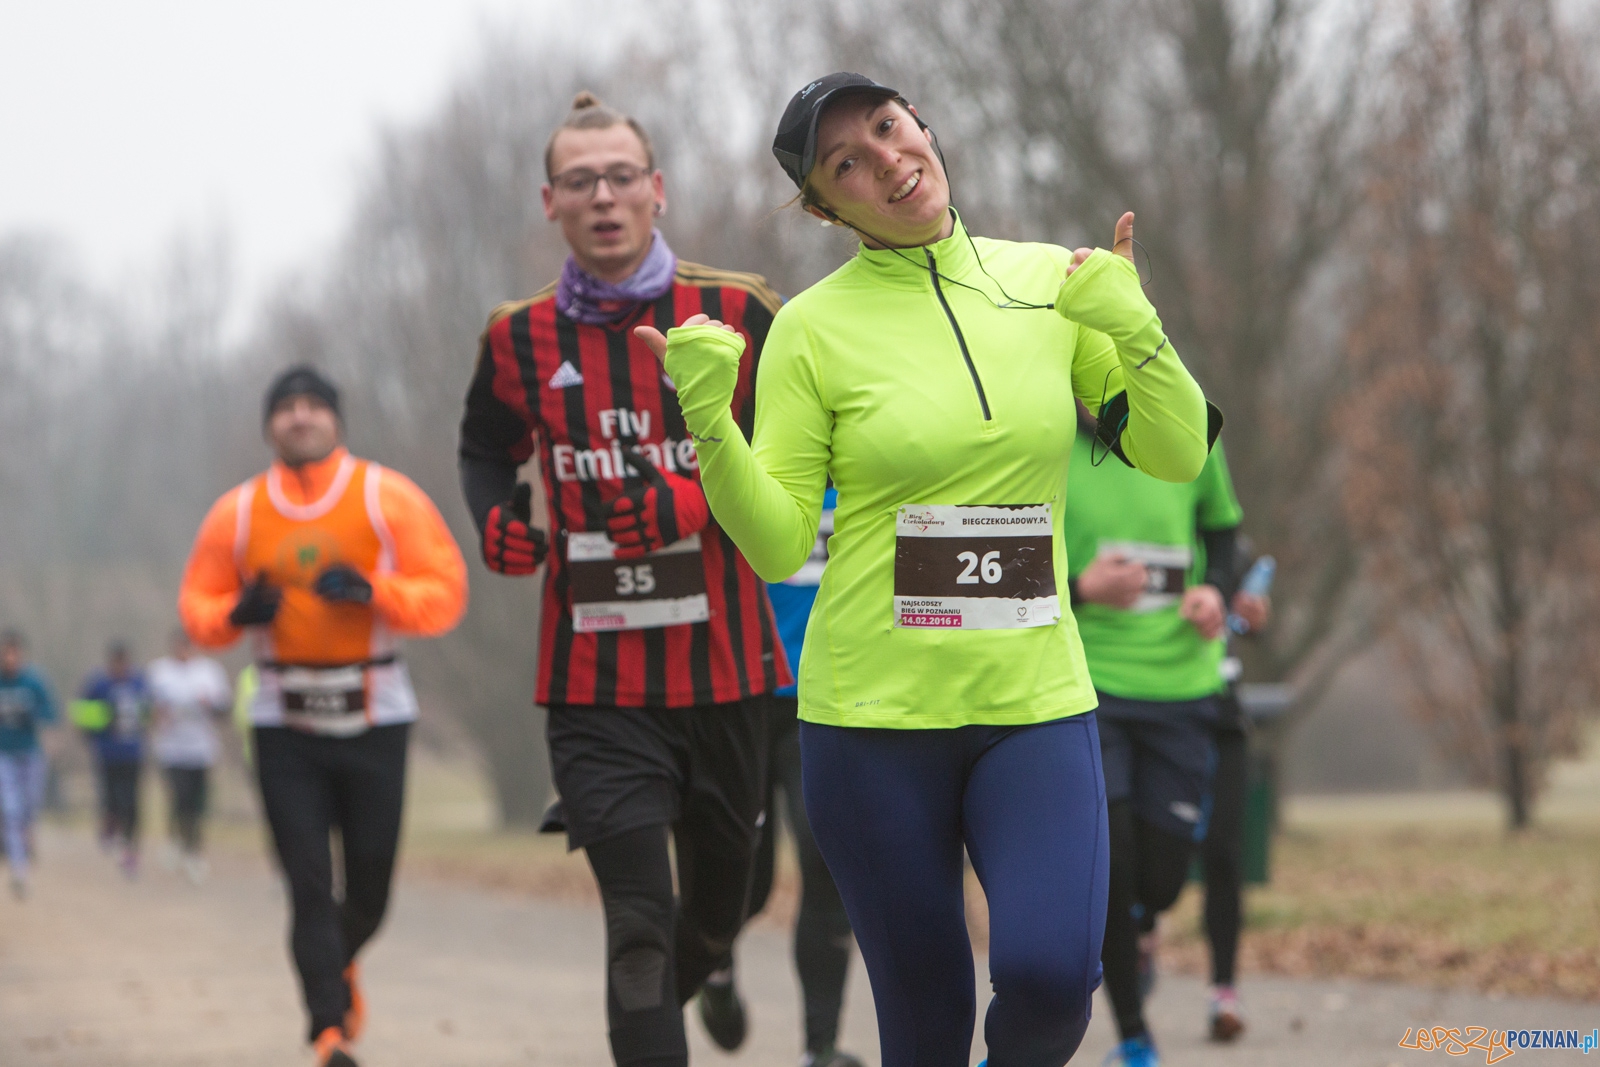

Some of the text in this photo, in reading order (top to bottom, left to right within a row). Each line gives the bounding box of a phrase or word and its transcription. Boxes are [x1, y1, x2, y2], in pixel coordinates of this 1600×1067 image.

[599, 408, 651, 439] Fly
[962, 516, 1048, 526] BIEGCZEKOLADOWY.PL
[614, 564, 656, 595] 35
[956, 550, 1003, 585] 26
[902, 616, 952, 625] 14.02.2016
